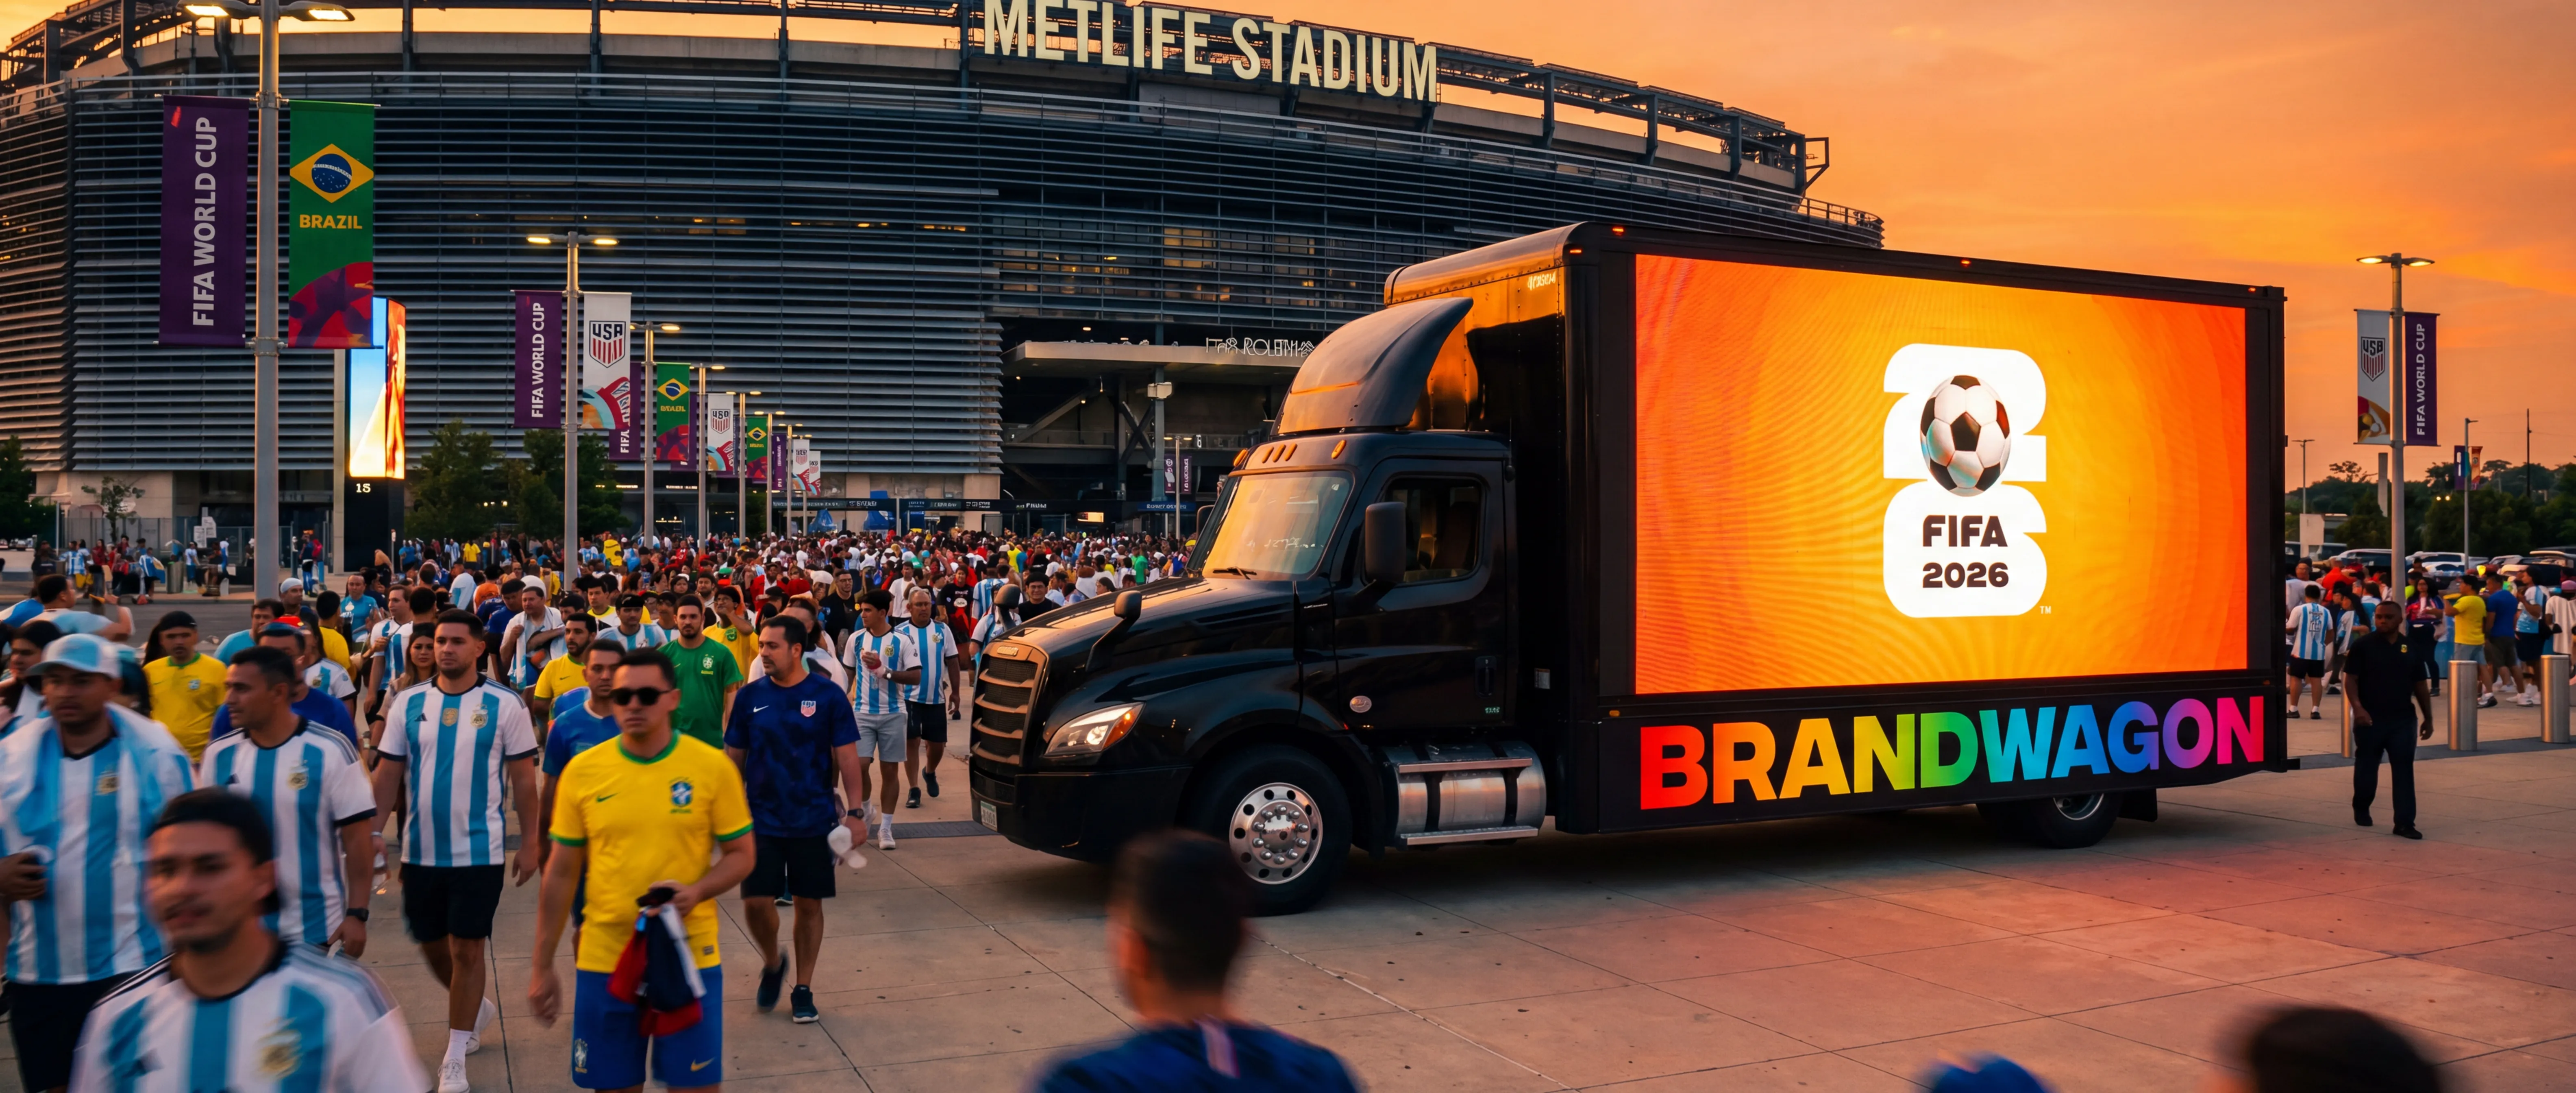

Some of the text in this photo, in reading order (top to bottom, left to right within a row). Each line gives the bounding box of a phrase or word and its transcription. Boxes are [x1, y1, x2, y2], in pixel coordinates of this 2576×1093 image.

[984, 0, 1437, 102] METLIFE STADIUM
[193, 117, 217, 326] FIFA WORLD CUP
[300, 214, 363, 229] BRAZIL
[532, 303, 544, 418] FIFA WORLD CUP
[592, 323, 623, 340] USA
[2416, 324, 2426, 435] FIFA WORLD CUP
[1923, 515, 2008, 547] FIFA
[1923, 562, 2009, 588] 2026
[1640, 695, 2264, 810] BRANDWAGON
